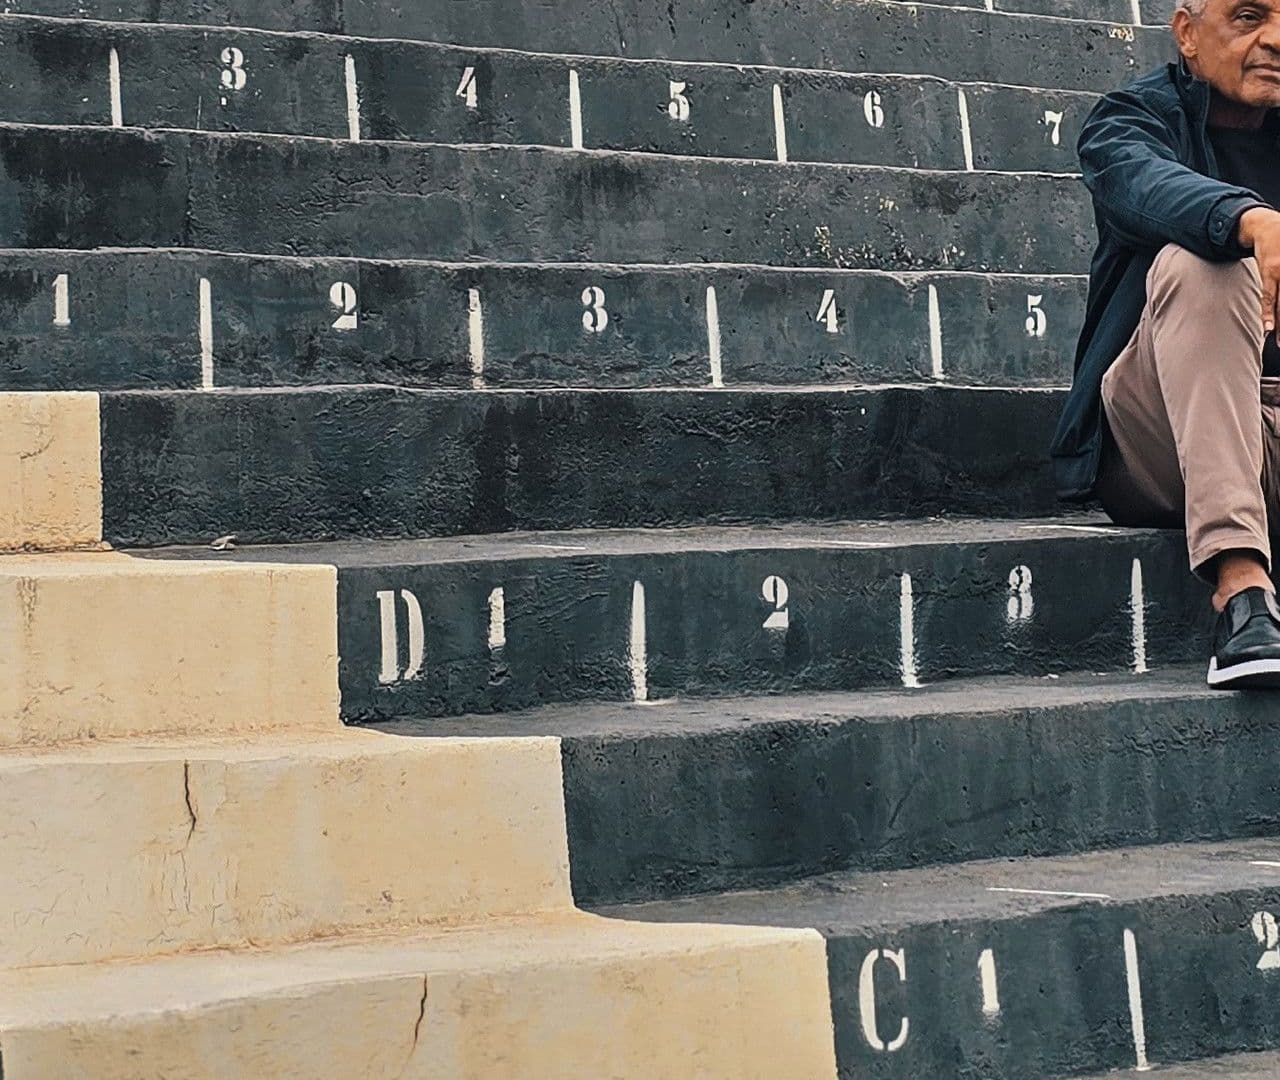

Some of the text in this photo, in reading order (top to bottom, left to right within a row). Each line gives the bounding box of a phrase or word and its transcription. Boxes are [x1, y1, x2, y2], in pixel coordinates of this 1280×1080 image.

[221, 48, 246, 90] 3
[456, 67, 477, 110] 4
[668, 81, 689, 121] 5
[864, 92, 883, 127] 6
[1045, 111, 1062, 144] 7
[53, 274, 70, 325] 1
[330, 282, 357, 329] 2
[582, 287, 608, 332] 3
[817, 290, 838, 333] 4
[1026, 295, 1046, 336] 5
[377, 589, 424, 683] D
[488, 587, 506, 649] 1
[763, 576, 788, 630] 2
[859, 948, 908, 1051] C
[978, 949, 999, 1018] 1
[1252, 912, 1280, 970] 2
